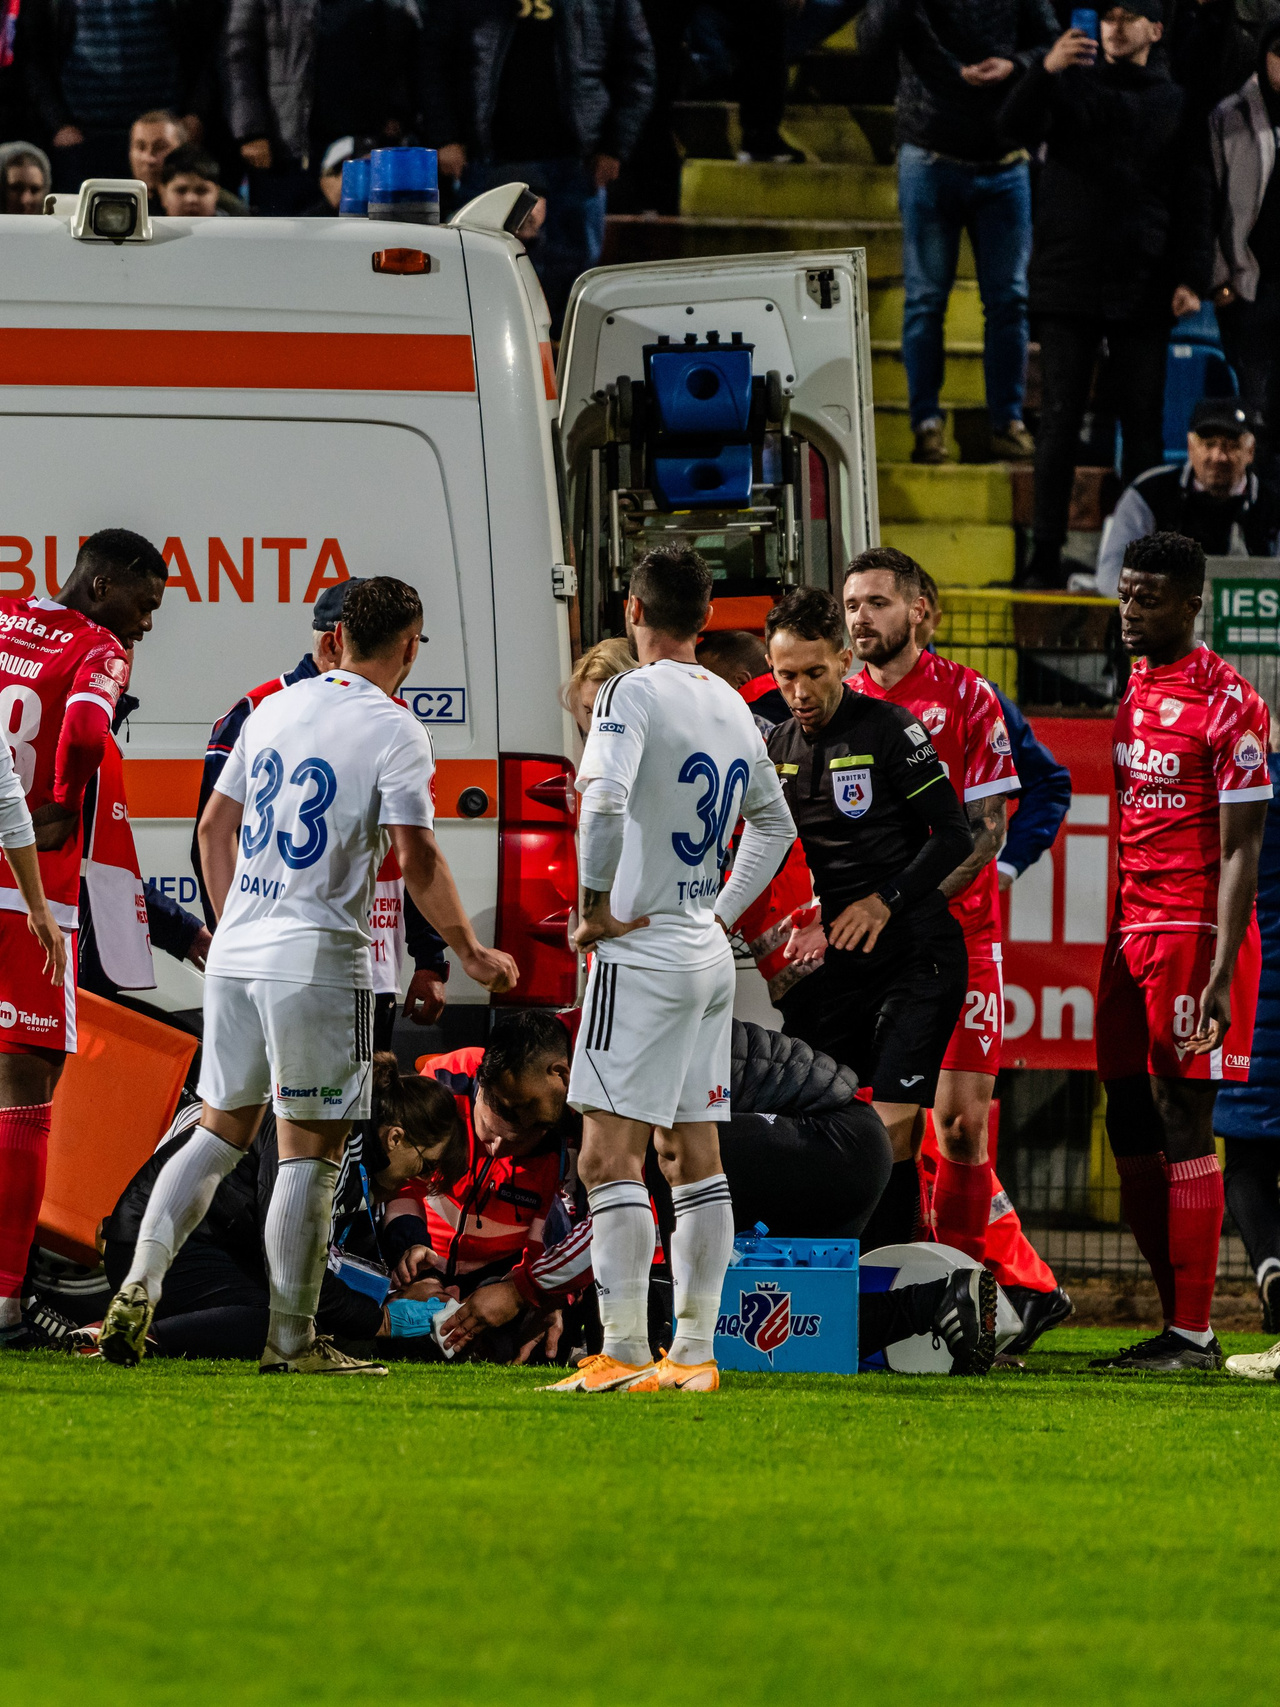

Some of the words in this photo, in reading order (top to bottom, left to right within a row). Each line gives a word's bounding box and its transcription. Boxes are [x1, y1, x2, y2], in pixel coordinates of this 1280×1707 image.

[412, 693, 453, 718] C2
[837, 773, 867, 782] ARBITRU
[1154, 776, 1181, 785] SPORT
[241, 747, 338, 870] 33
[671, 751, 750, 870] 30
[18, 1010, 59, 1028] Tehnic
[964, 990, 998, 1033] 24
[1173, 994, 1196, 1038] 8
[26, 1025, 50, 1033] GROUP
[280, 1086, 319, 1098] Smart
[320, 1086, 343, 1098] Eco
[323, 1097, 343, 1106] Plus
